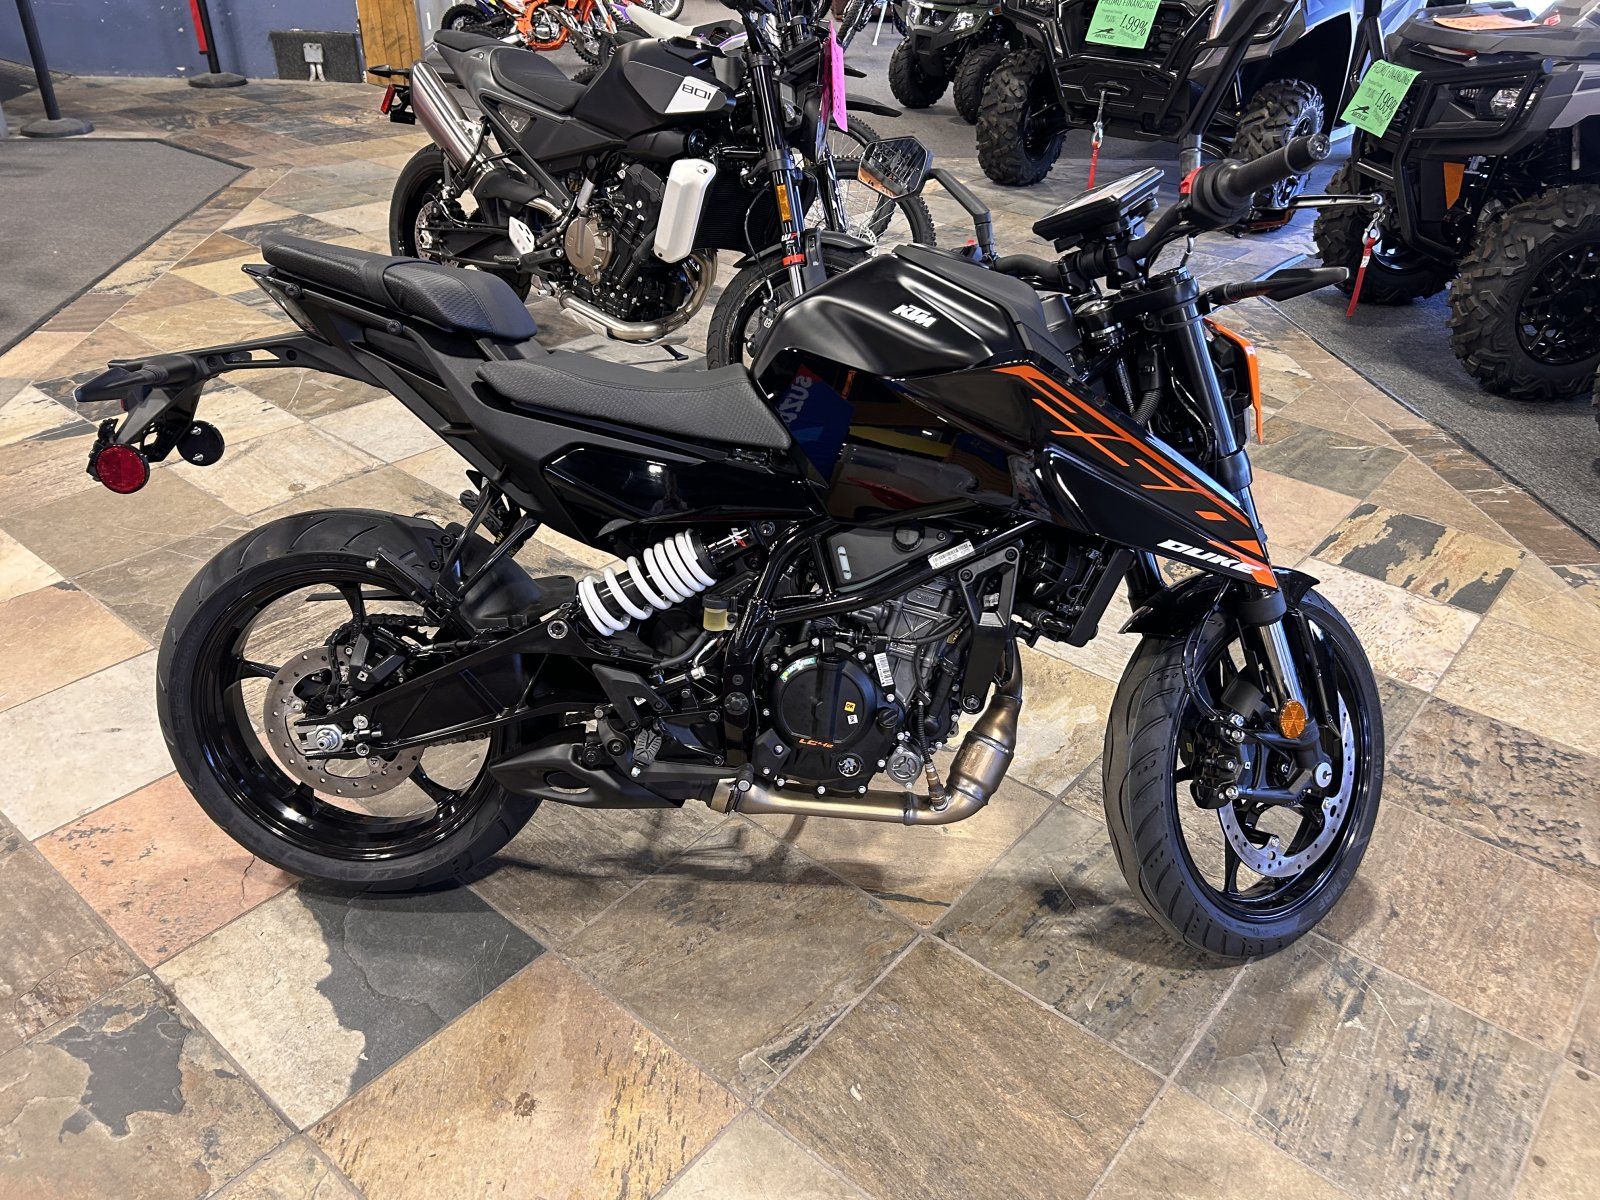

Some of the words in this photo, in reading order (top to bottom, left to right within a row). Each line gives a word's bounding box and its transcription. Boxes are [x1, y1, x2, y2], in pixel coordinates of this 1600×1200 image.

[1119, 13, 1149, 37] 1.99%
[682, 83, 711, 100] 801
[1374, 88, 1399, 121] 1.99%
[891, 304, 937, 328] KTM
[1156, 539, 1263, 575] DUKE
